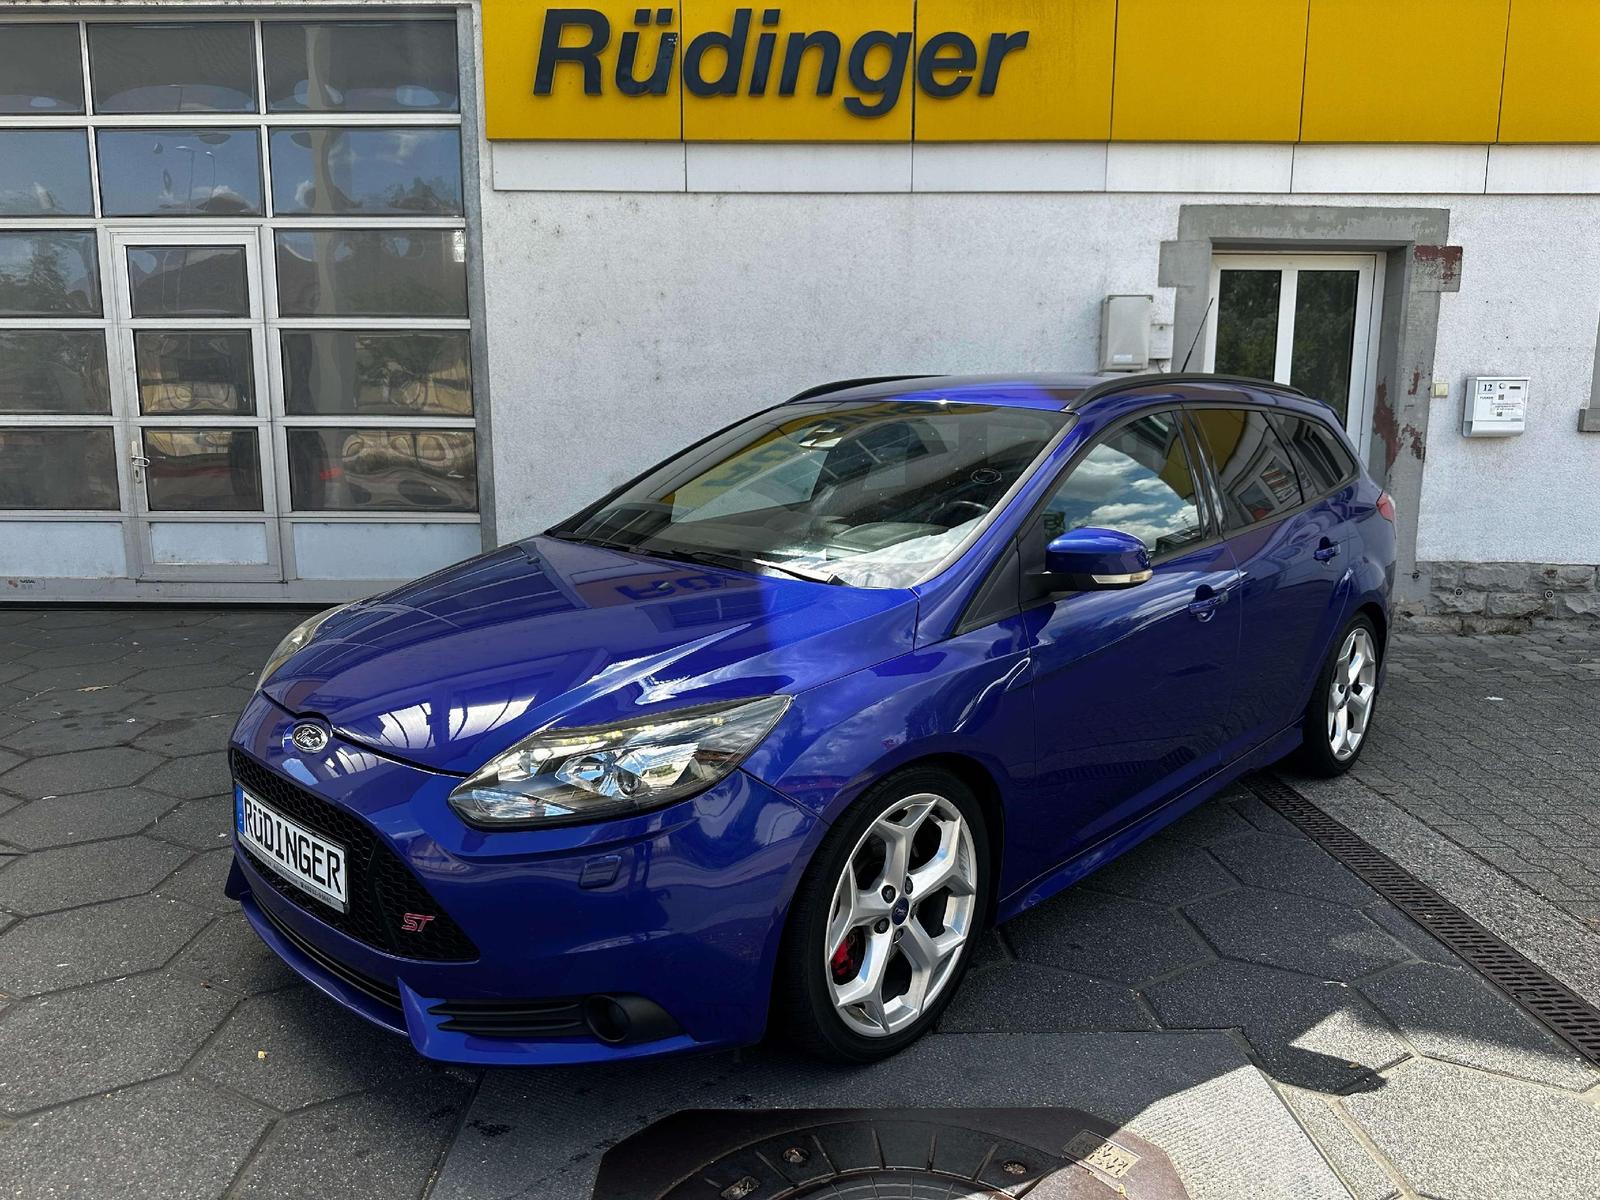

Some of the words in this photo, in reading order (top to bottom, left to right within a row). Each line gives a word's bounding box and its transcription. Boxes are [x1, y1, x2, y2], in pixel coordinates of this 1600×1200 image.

[532, 7, 1030, 118] Rüdinger
[1483, 383, 1493, 391] 12
[243, 797, 342, 895] RÜDINGER
[401, 912, 436, 933] ST
